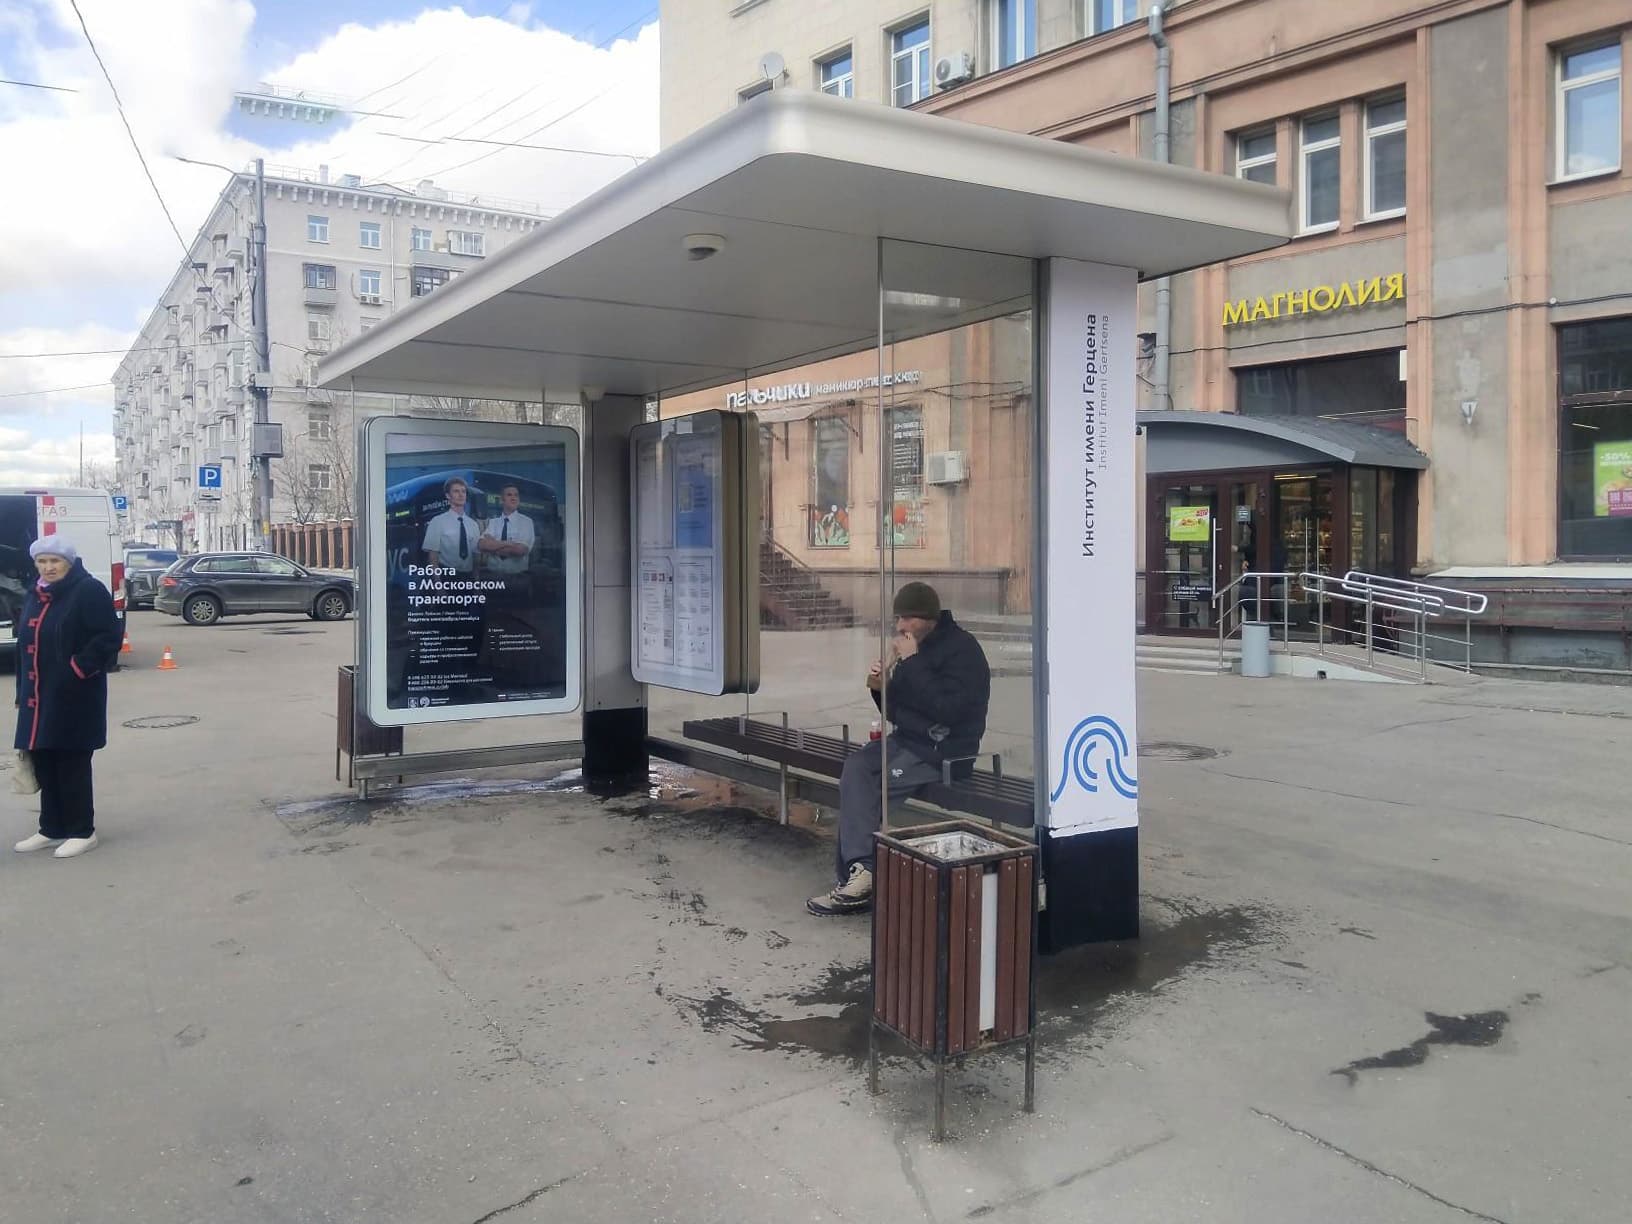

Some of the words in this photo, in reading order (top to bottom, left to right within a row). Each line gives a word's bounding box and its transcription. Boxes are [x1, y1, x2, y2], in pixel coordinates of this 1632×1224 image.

[1222, 273, 1406, 326] МАГНОЛИЯ
[1083, 314, 1098, 394] Герцена
[1085, 400, 1096, 463] имени
[204, 468, 218, 486] P
[1082, 468, 1097, 557] Институт
[408, 564, 456, 576] Работа
[408, 581, 417, 591] в
[419, 579, 506, 591] Московском
[407, 594, 487, 607] транспорте
